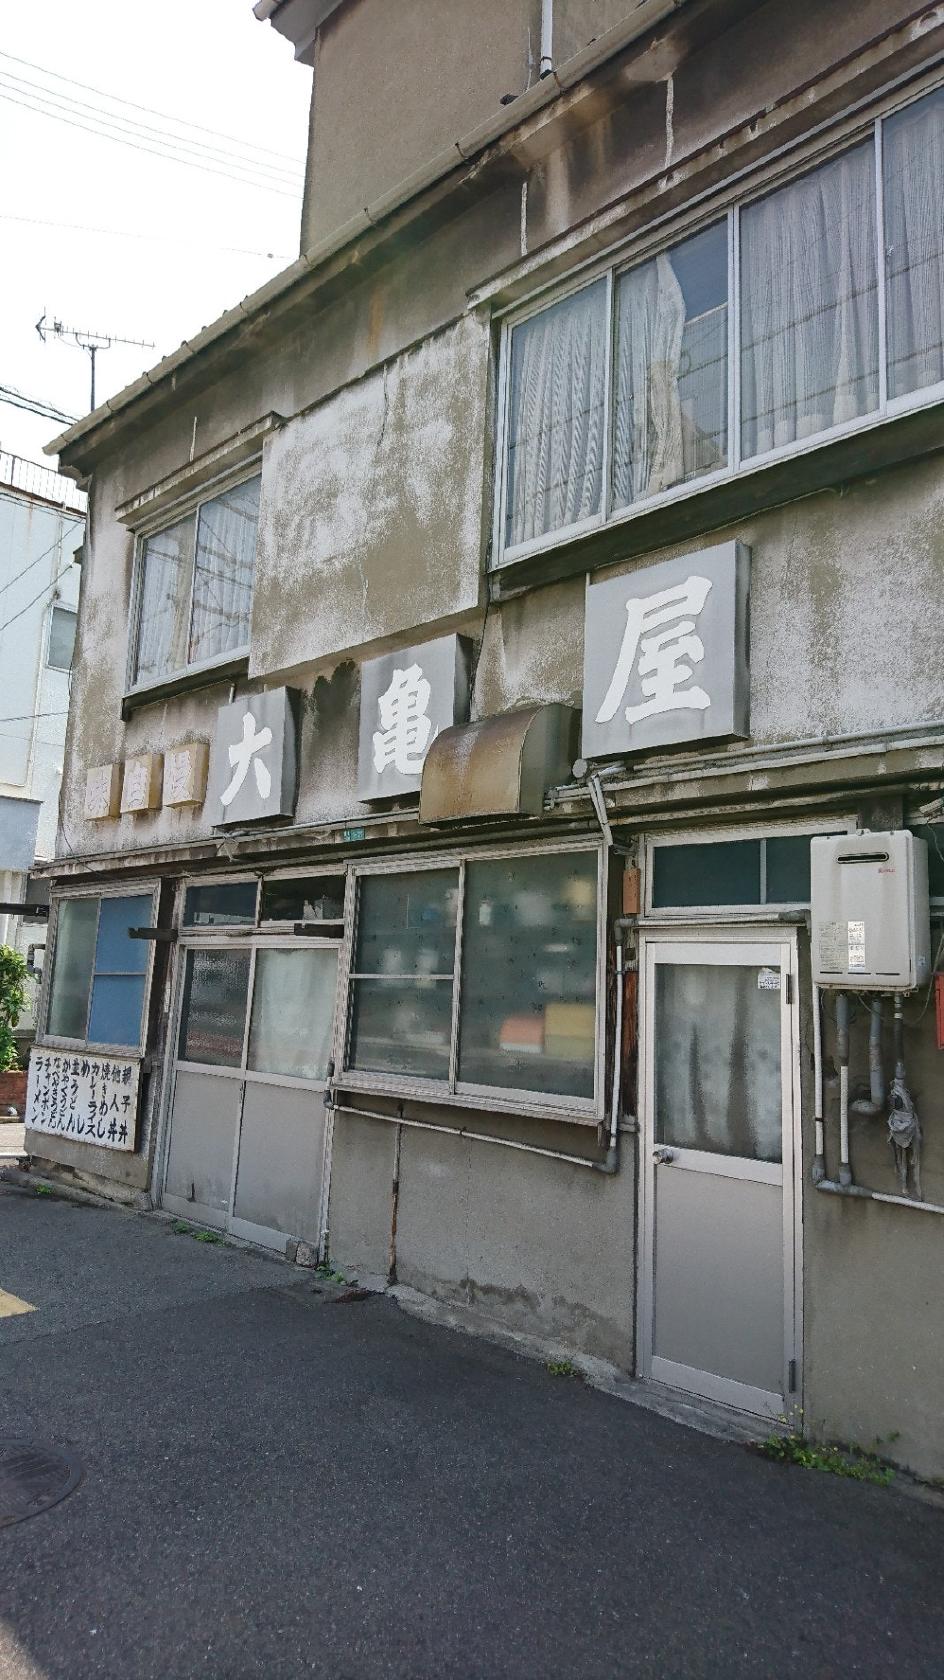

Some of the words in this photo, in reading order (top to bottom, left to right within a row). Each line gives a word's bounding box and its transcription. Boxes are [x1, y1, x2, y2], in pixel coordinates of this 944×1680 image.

[31, 1057, 43, 1124] ラーメン
[85, 1062, 100, 1138] カレーライス
[97, 1062, 111, 1138] 焼きめし
[107, 1064, 121, 1142] 他人丼
[118, 1065, 132, 1144] 親子丼
